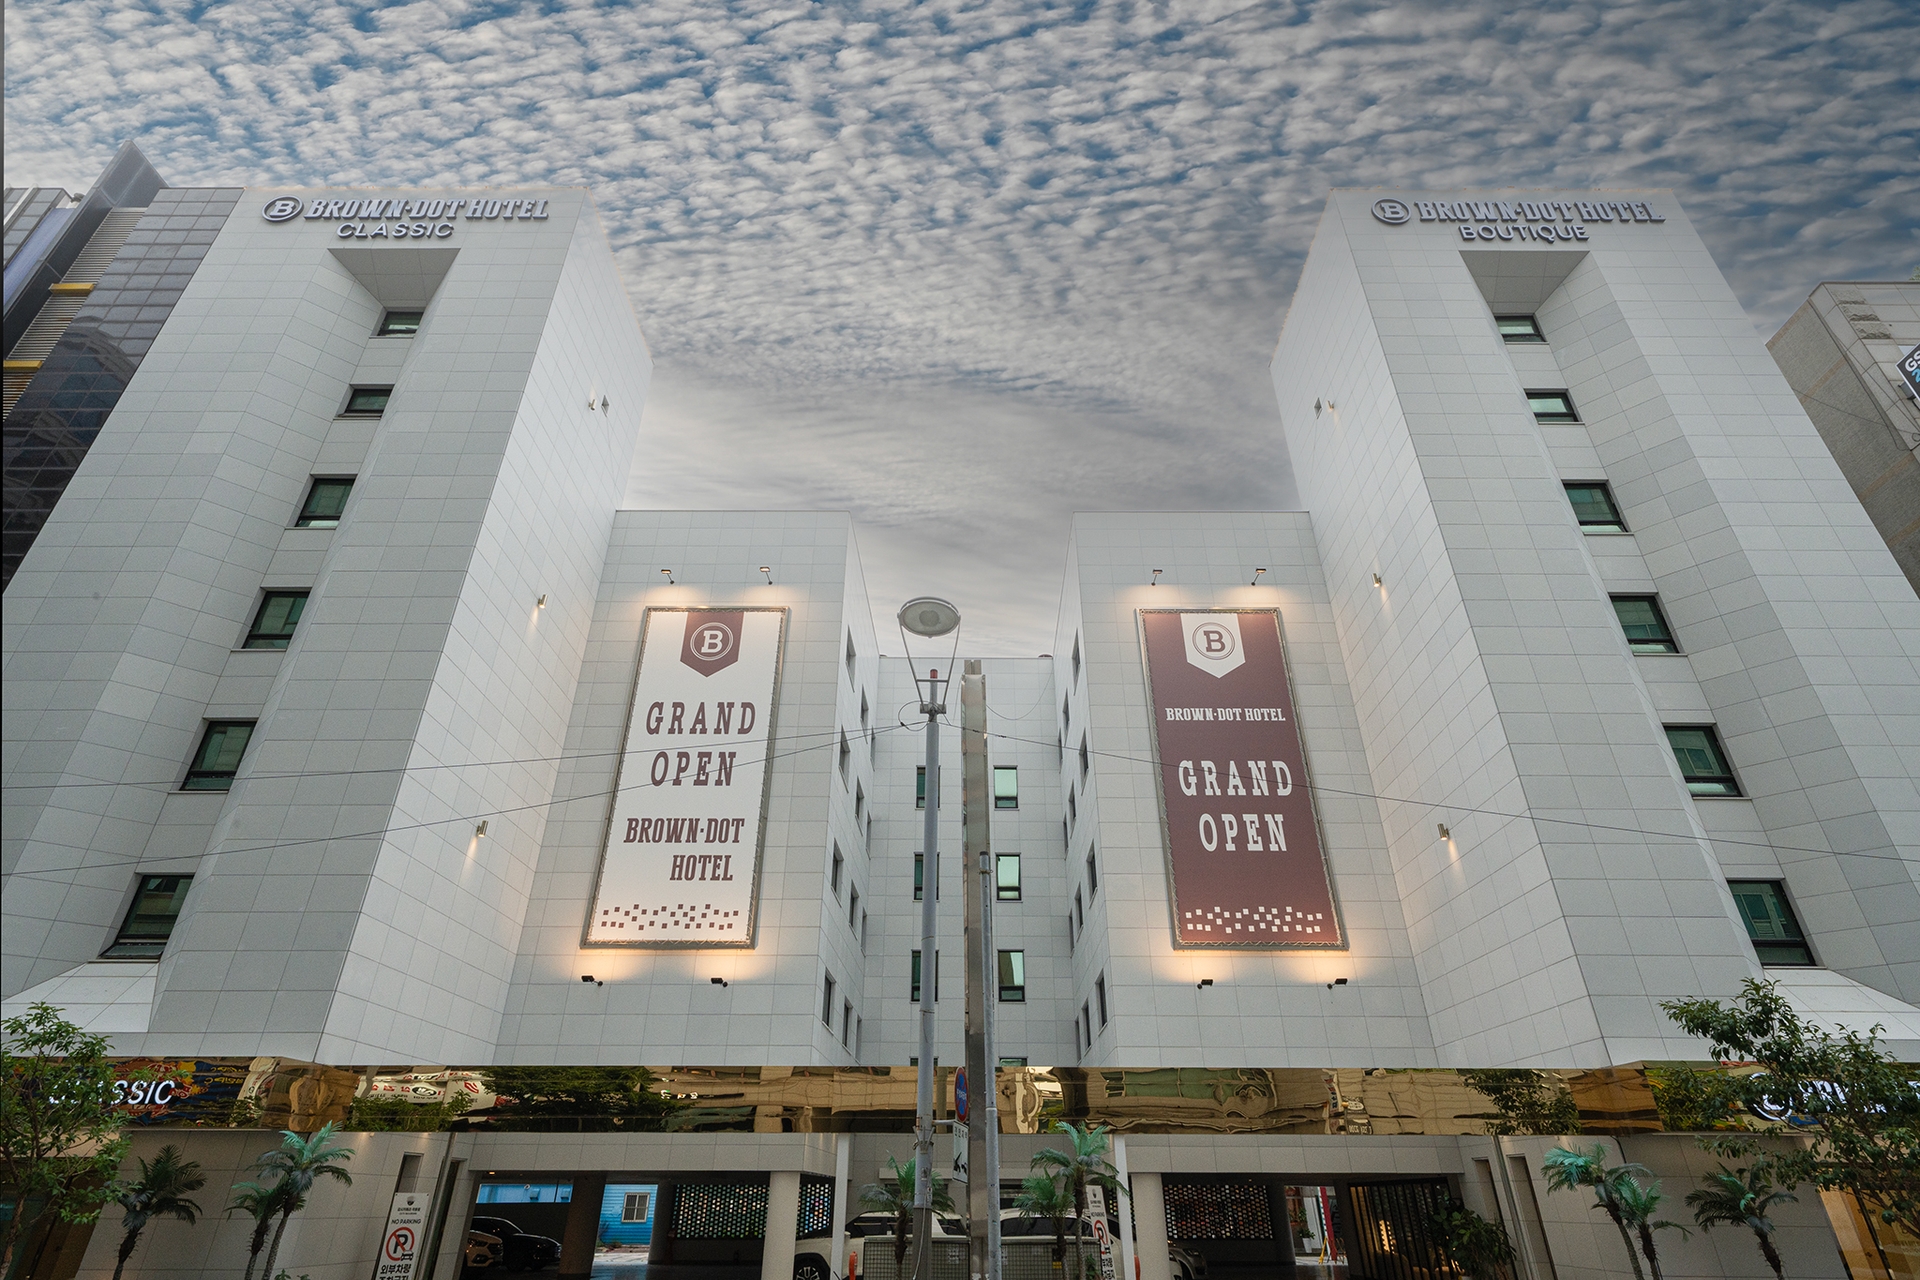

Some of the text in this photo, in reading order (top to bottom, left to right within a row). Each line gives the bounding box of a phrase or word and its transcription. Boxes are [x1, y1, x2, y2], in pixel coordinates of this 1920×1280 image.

[465, 199, 549, 220] HOTEL
[1573, 201, 1666, 223] HOTEL
[336, 222, 455, 239] CLASSIC
[1458, 224, 1590, 244] BOUTIQUE
[700, 630, 724, 653] B
[1203, 630, 1226, 652] B
[645, 701, 756, 735] GRAND
[1244, 708, 1286, 722] HOTEL
[650, 751, 737, 787] OPEN
[1178, 759, 1293, 797] GRAND
[1198, 813, 1288, 852] OPEN
[669, 854, 734, 882] HOTEL
